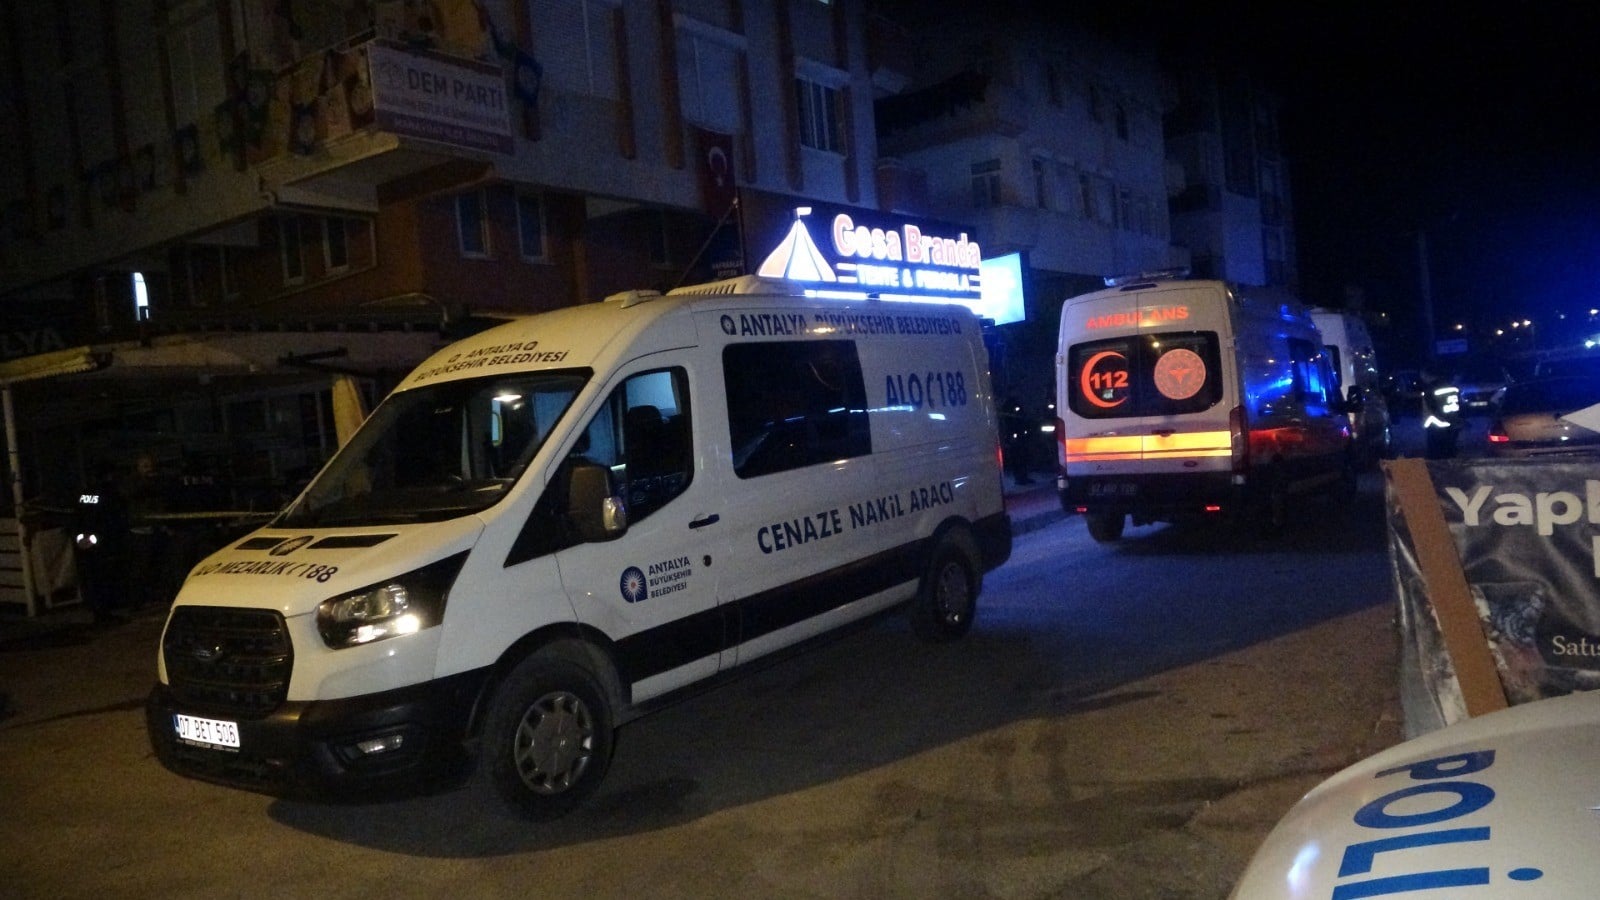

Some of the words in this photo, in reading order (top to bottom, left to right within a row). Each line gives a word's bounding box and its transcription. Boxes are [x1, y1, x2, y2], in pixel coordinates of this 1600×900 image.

[407, 68, 447, 96] DEM
[453, 78, 505, 111] PARTİ
[904, 224, 981, 269] Branda
[741, 314, 806, 336] ANTALYA
[1086, 306, 1189, 329] AMBULANS
[464, 343, 522, 360] ANTALYA
[886, 373, 923, 409] ALO
[936, 371, 967, 407] 188
[1091, 371, 1128, 389] 112
[757, 509, 843, 554] CENAZE
[848, 494, 904, 529] NAKİL
[909, 481, 955, 513] ARACI
[216, 561, 294, 576] MEZARLIK
[299, 563, 338, 583] 188
[649, 556, 690, 576] ANTALYA
[1552, 635, 1600, 657] Satı
[179, 717, 190, 736] 07
